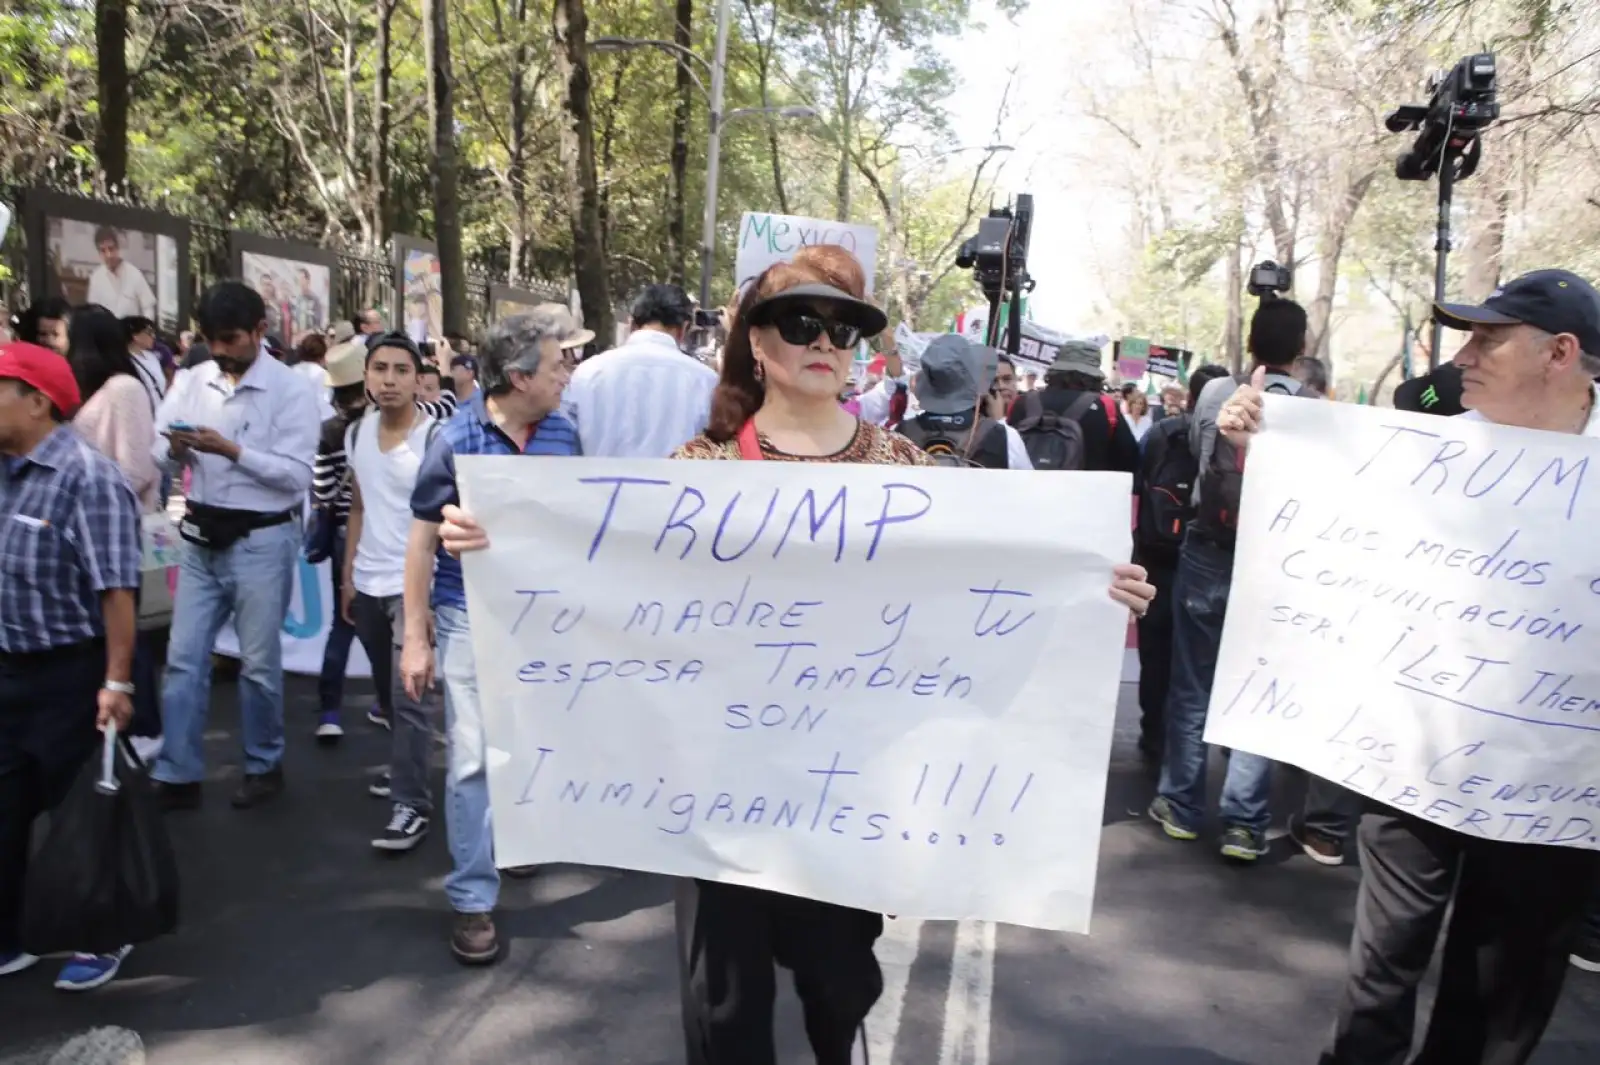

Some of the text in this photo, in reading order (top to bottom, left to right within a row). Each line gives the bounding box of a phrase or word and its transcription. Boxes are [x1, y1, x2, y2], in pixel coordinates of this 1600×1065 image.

[1354, 424, 1590, 520] TRUM
[578, 476, 932, 563] TRUMP
[1268, 498, 1301, 532] A
[1316, 515, 1380, 551] LOS
[724, 704, 828, 732] SON
[1425, 741, 1600, 809] CENSUR
